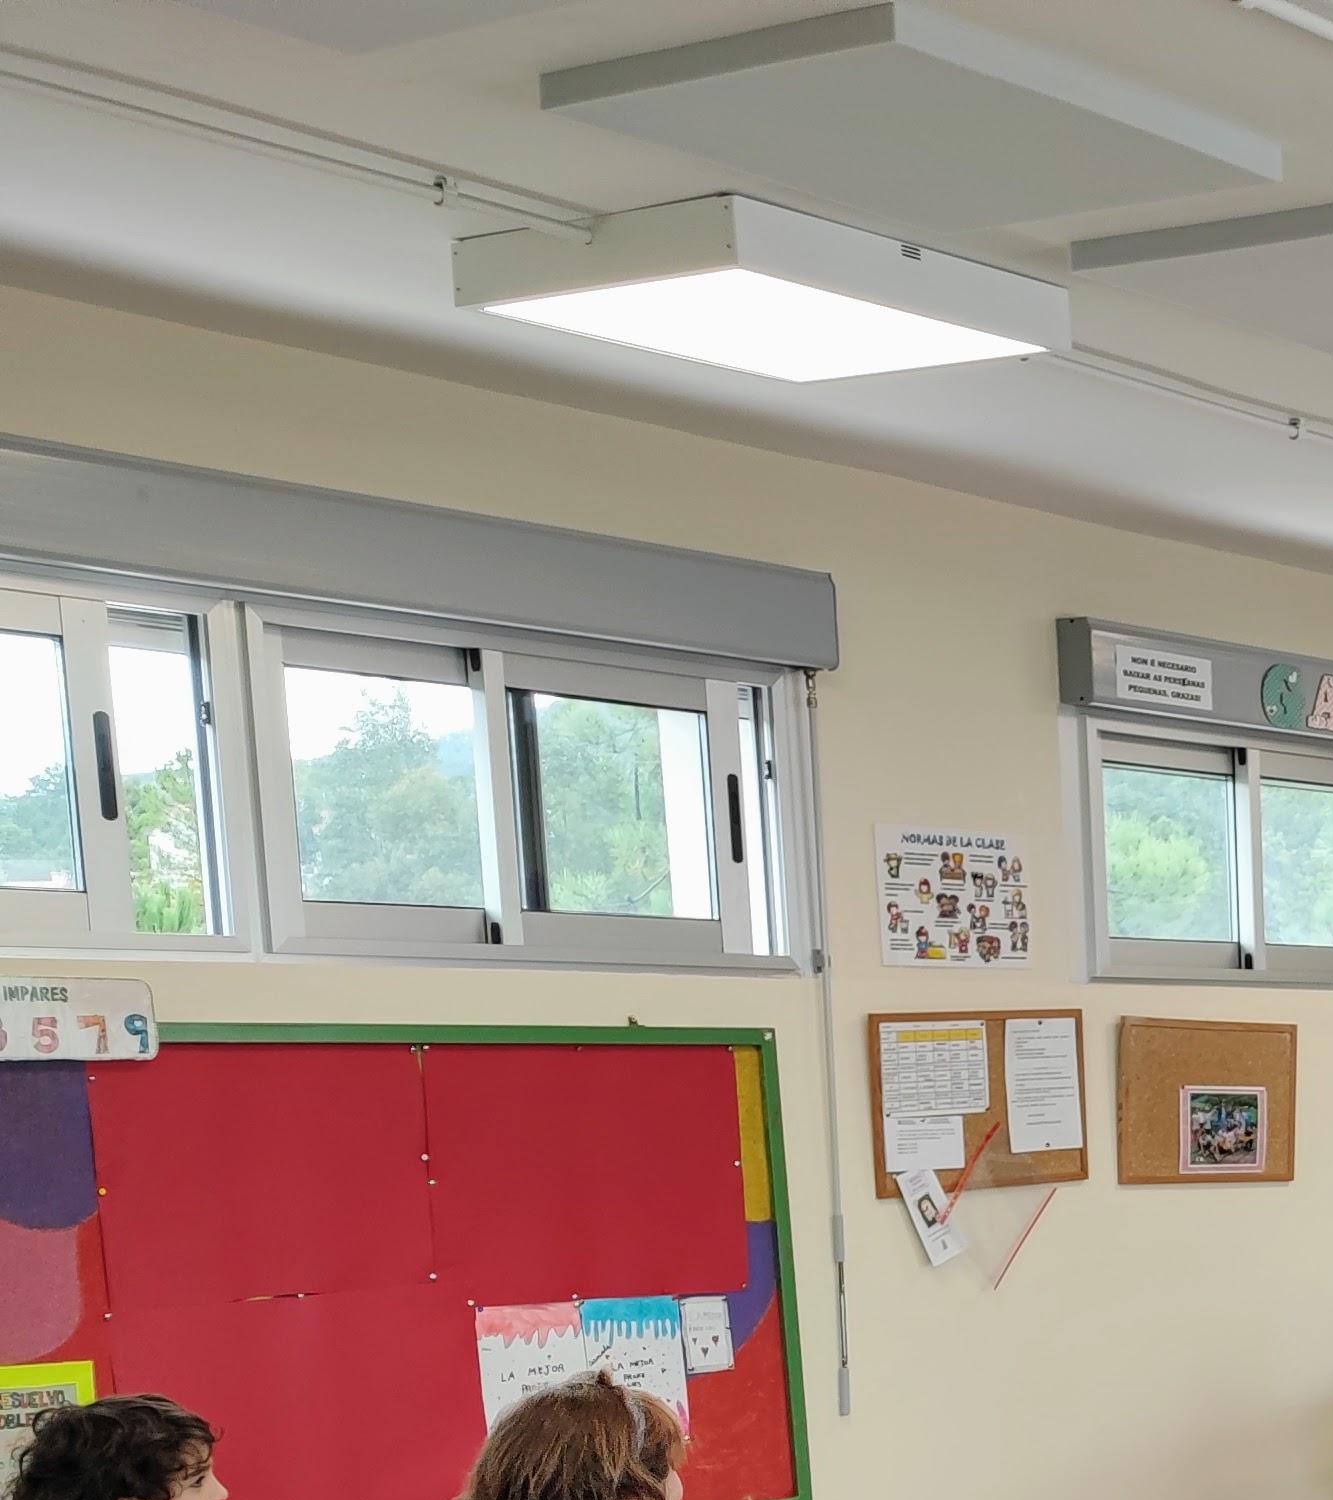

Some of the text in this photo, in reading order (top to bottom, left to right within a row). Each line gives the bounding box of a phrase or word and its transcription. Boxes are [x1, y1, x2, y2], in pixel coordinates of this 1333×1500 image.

[1157, 661, 1197, 673] NECESARIO
[901, 833, 1006, 850] NORMAS DE LA CLASE
[3, 986, 69, 1003] IMPARES
[32, 1016, 59, 1053] 5
[77, 1014, 109, 1054] 7
[124, 1013, 149, 1054] 9
[501, 1363, 565, 1383] LA MEJOR
[0, 1390, 65, 1409] ESUELVO
